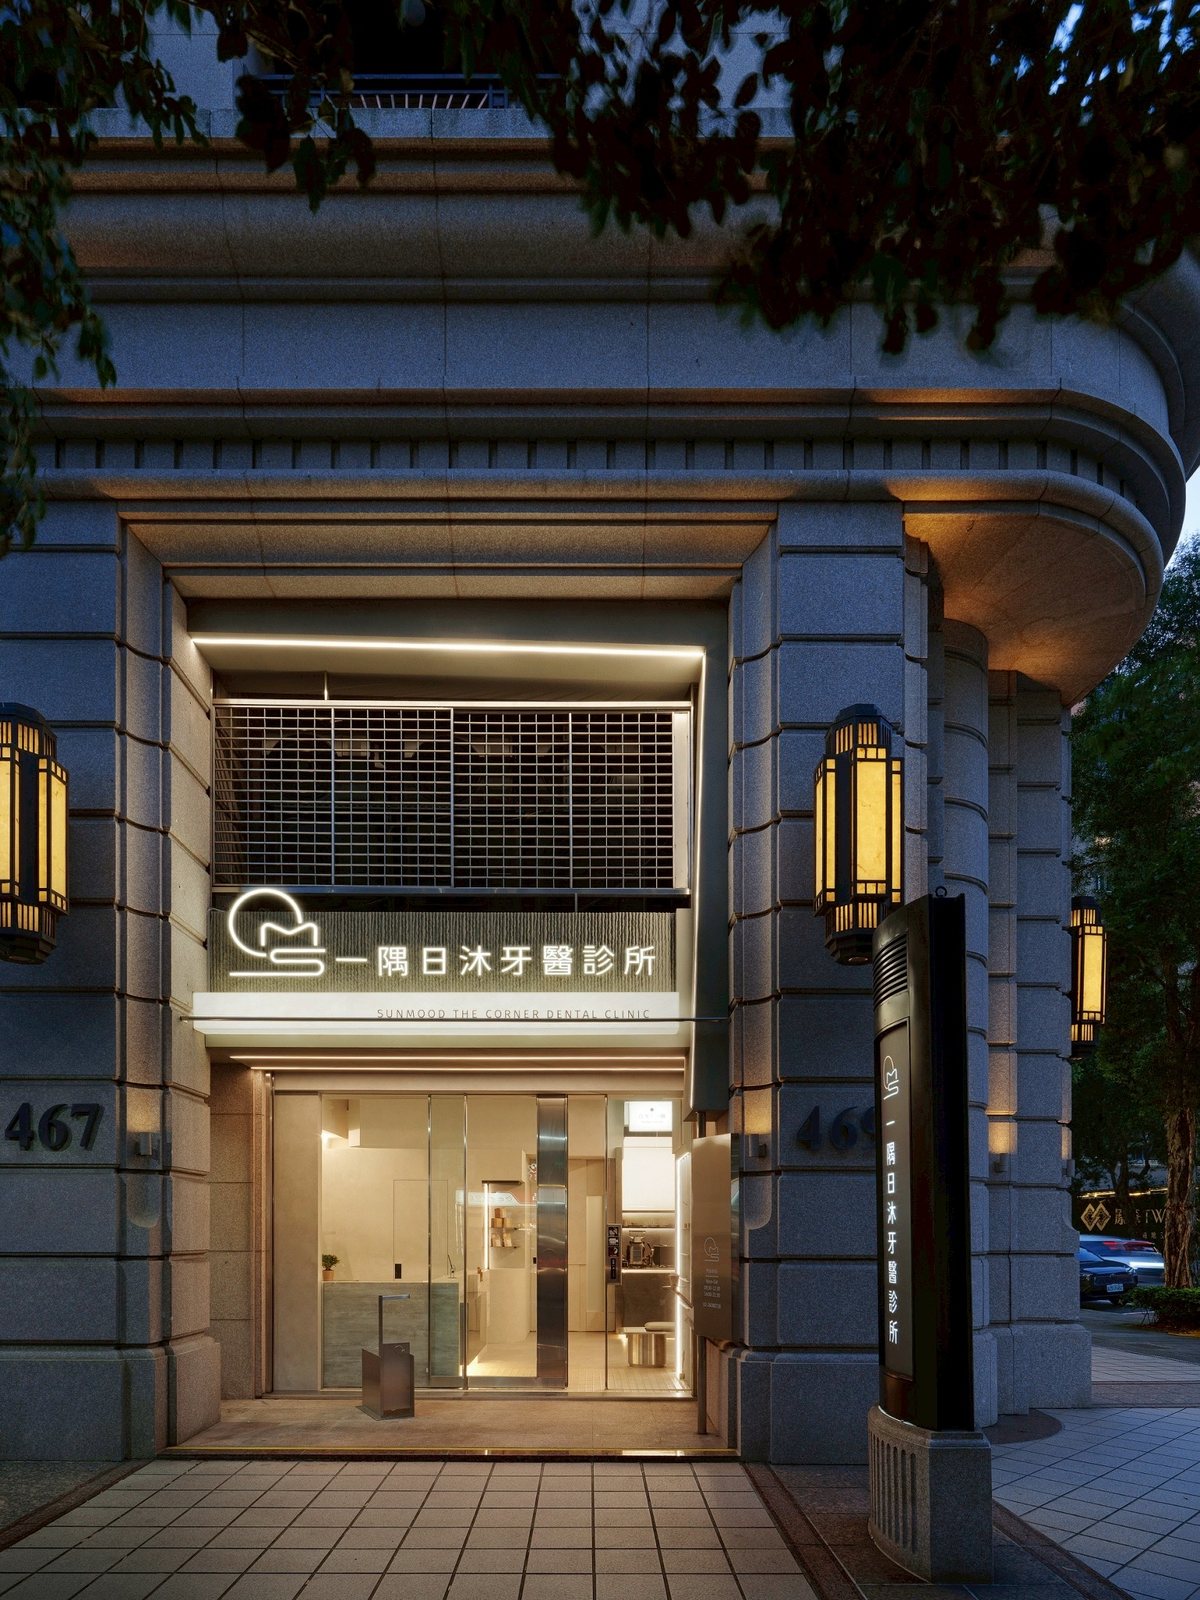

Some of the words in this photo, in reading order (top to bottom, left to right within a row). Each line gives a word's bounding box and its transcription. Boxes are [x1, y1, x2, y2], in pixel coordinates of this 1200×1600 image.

[335, 944, 657, 978] 一隅日沐牙醫診所
[376, 1008, 446, 1020] SUNMOOD
[452, 1008, 478, 1020] THE
[485, 1008, 540, 1020] CORNER
[546, 1009, 598, 1020] DENTAL
[604, 1009, 650, 1020] CLINIC
[5, 1102, 105, 1152] 467
[885, 1120, 898, 1345] 一隅日沐牙醫診所
